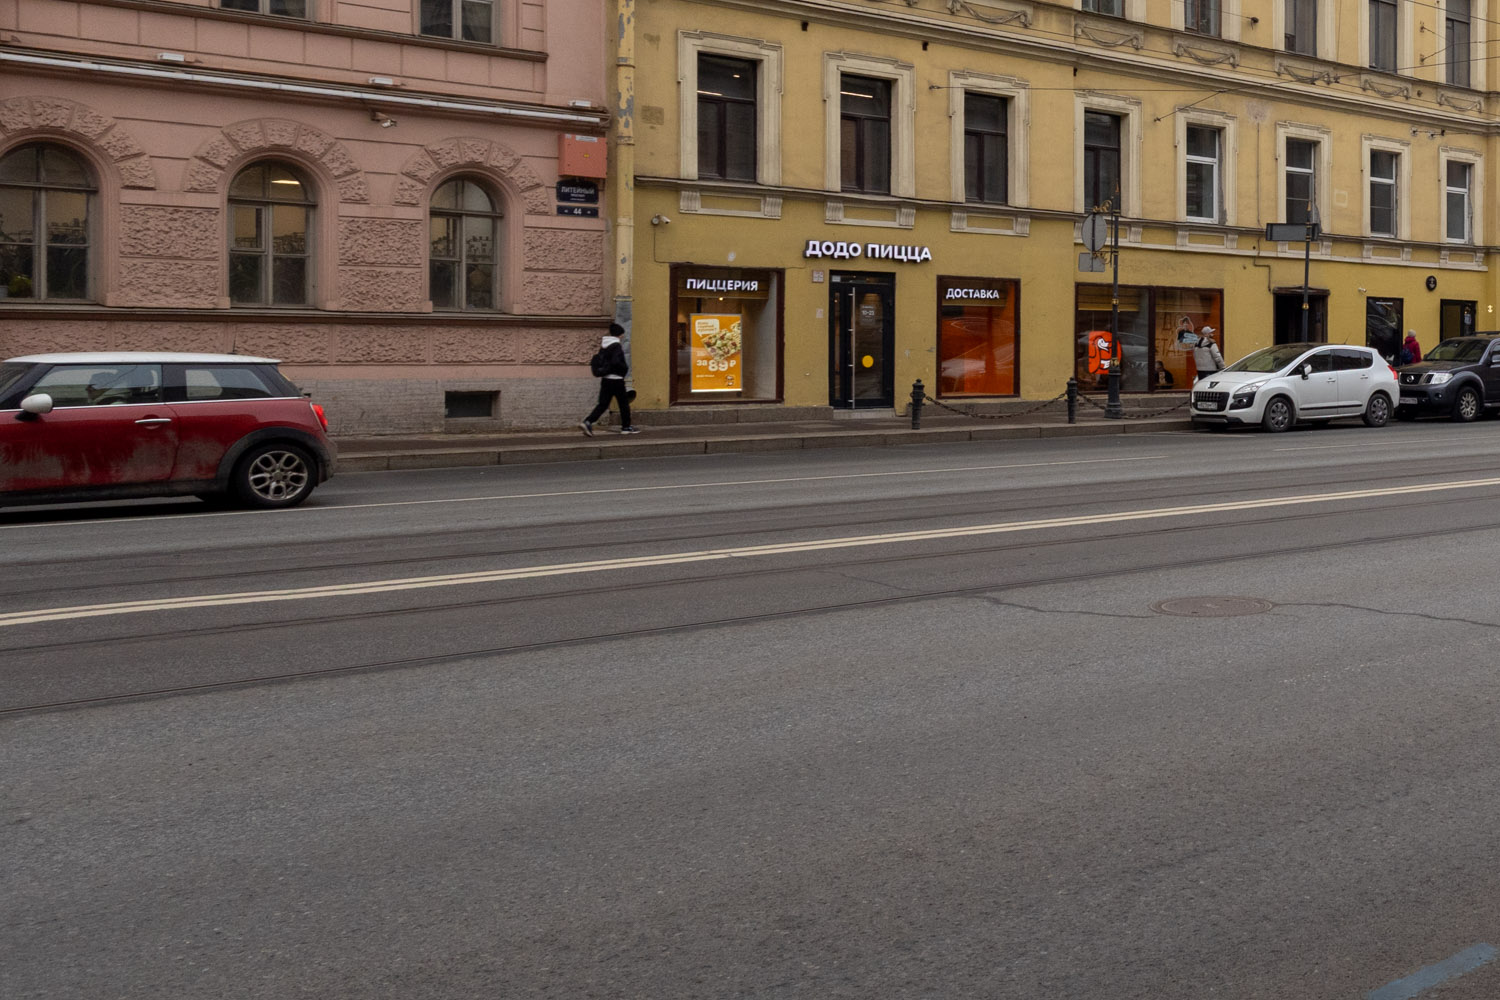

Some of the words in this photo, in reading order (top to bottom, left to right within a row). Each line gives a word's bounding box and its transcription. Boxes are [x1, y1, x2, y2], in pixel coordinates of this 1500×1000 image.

[573, 207, 582, 215] 44
[806, 240, 862, 258] ДОДО
[867, 243, 932, 263] ПИЦЦА
[686, 278, 759, 292] ПИЦЦЕРИЯ
[945, 288, 1000, 300] ДОСТАВКА
